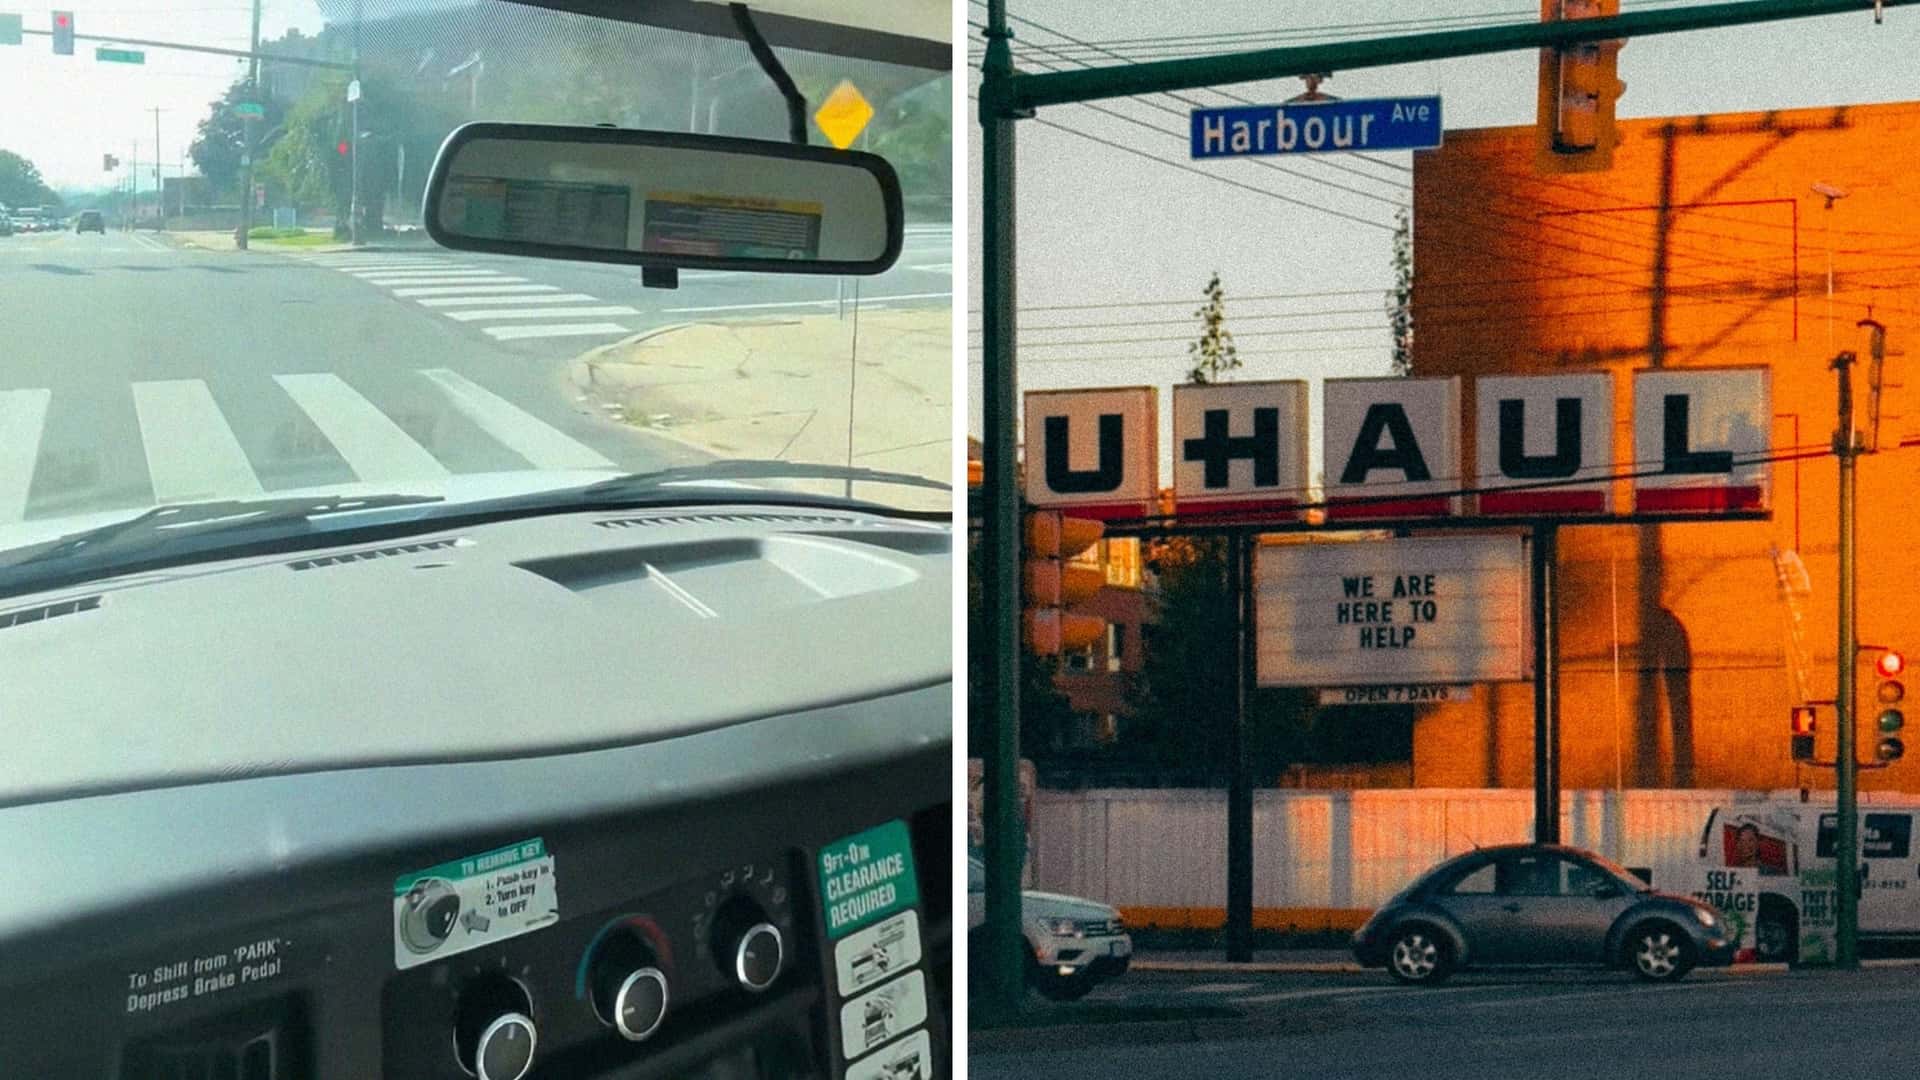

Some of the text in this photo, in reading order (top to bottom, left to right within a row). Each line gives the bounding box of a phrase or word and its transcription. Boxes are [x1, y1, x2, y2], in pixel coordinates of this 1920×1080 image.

[1203, 103, 1430, 152] Harbour Ave
[1343, 574, 1436, 598] WE ARE
[1337, 600, 1437, 624] HERE TO
[1360, 626, 1416, 648] HELP
[1345, 686, 1449, 701] OPEN 7 DAYS
[521, 868, 538, 880] key
[827, 852, 904, 901] CLEARANCE
[1707, 870, 1742, 890] SELF-
[485, 884, 536, 905] 2. Turn key
[831, 882, 896, 928] REQUIRED
[510, 900, 527, 914] OFF
[128, 972, 147, 989] To
[153, 961, 188, 983] Shift
[194, 954, 227, 974] from
[127, 957, 281, 1012] Depress Brake Pedal
